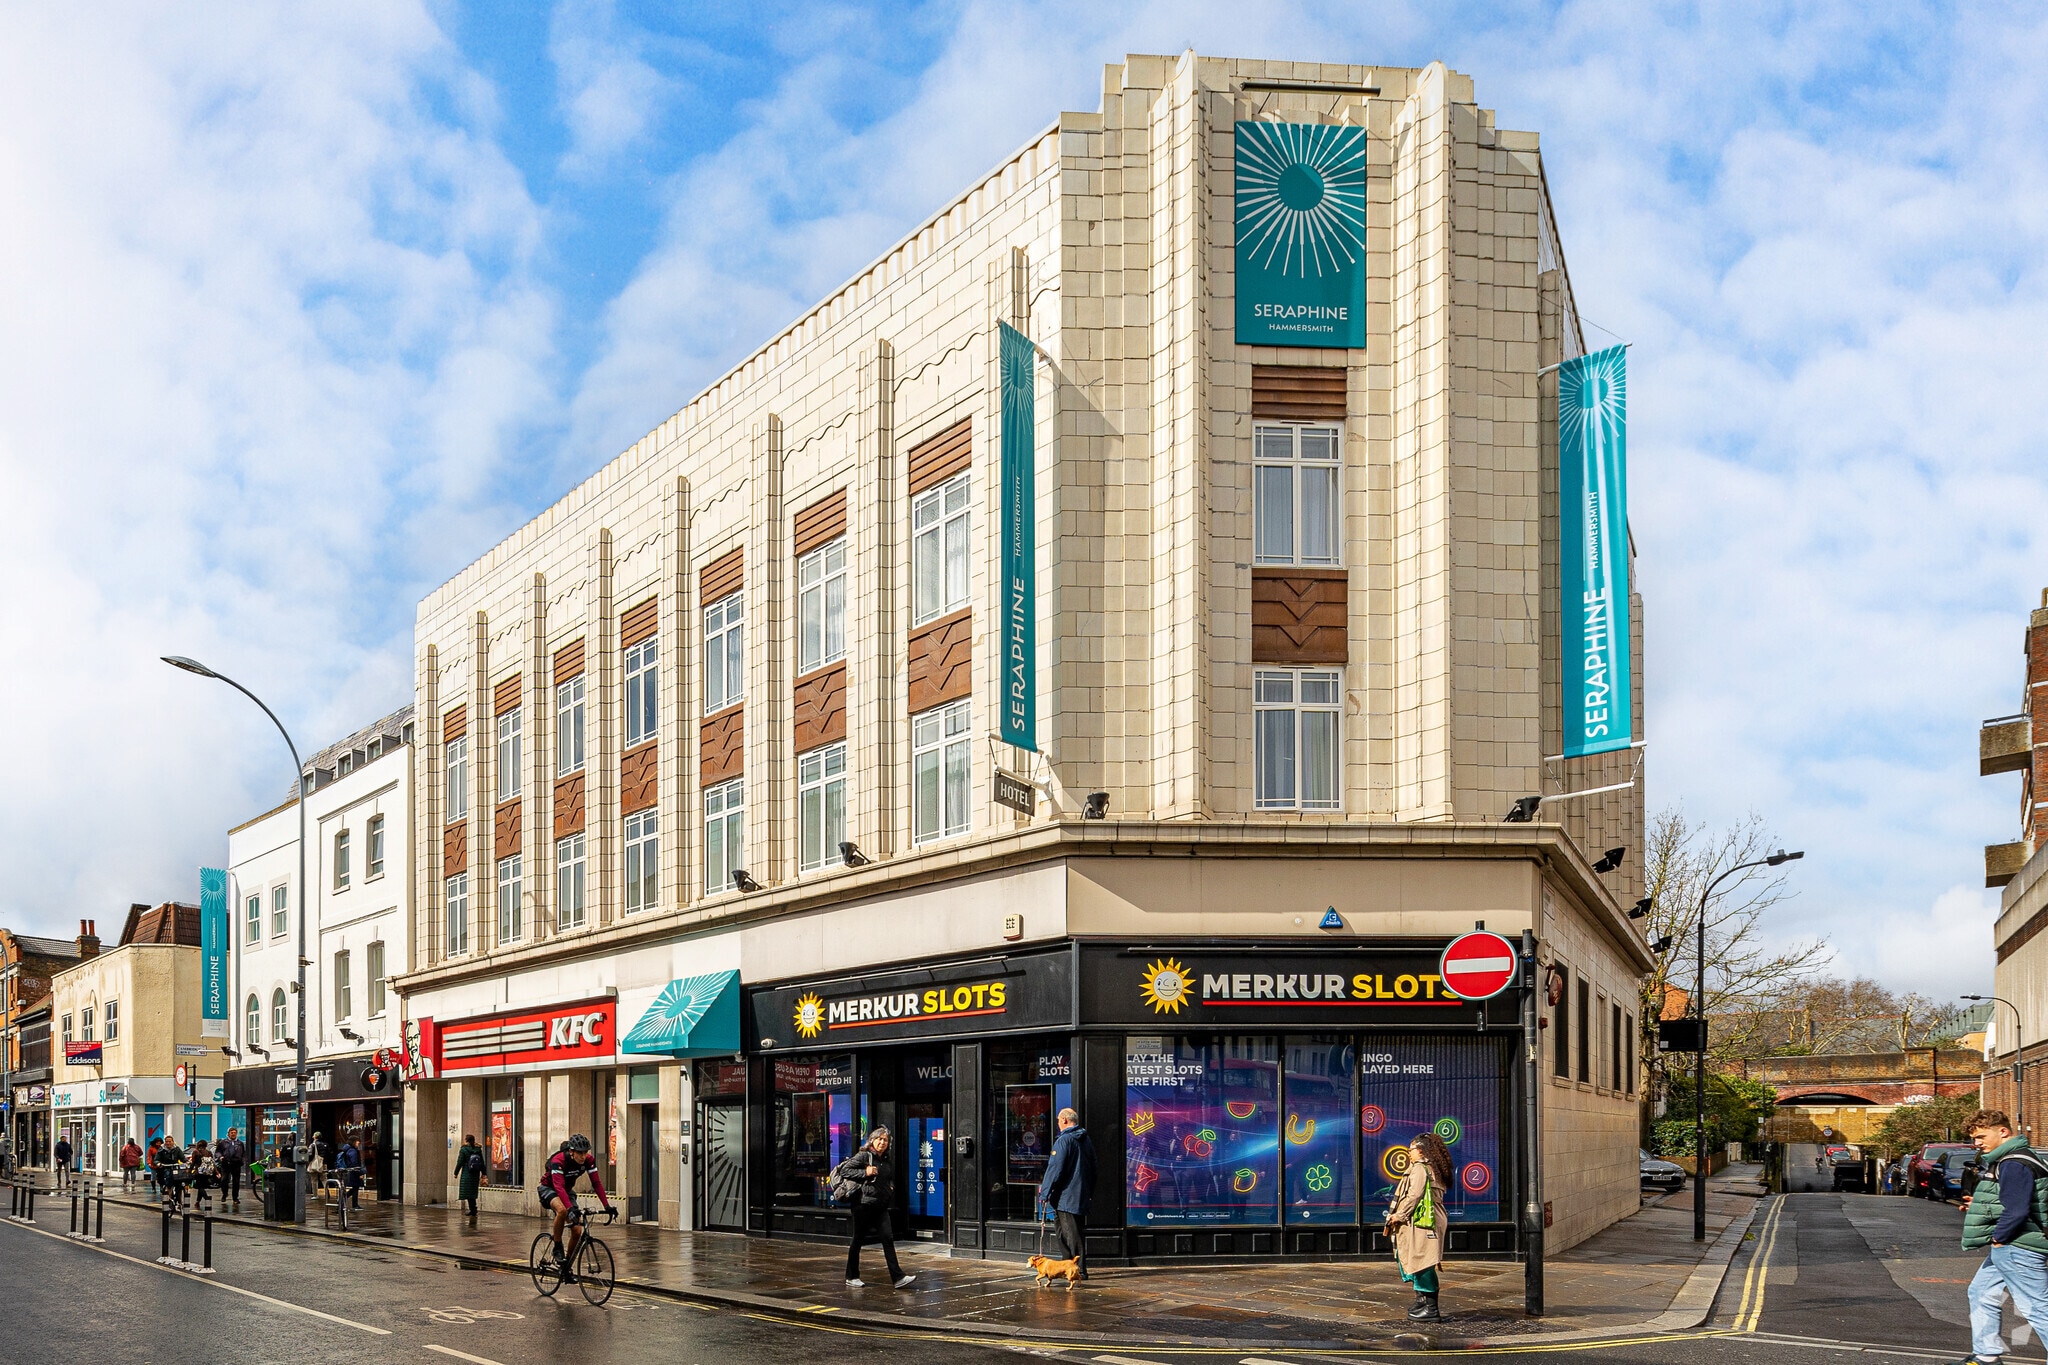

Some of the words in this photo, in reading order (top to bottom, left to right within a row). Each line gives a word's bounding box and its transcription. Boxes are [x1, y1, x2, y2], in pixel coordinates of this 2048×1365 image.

[1254, 303, 1348, 320] SERAPHINE
[1268, 323, 1334, 333] HAMMERSMITH
[1590, 490, 1599, 569] HAMMERSMITH
[1011, 576, 1025, 732] SERAPHINE
[1583, 586, 1610, 739] SERAPHINE
[1000, 782, 1030, 807] HOTEL
[210, 955, 220, 1015] SERAPHINE
[1202, 974, 1346, 999] MERKUR
[1351, 974, 1460, 999] SLOT
[828, 993, 920, 1024] MERKUR
[922, 982, 1006, 1014] SLOTS
[548, 1012, 605, 1048] KFC
[67, 1056, 101, 1064] Eddisons
[1039, 1055, 1063, 1066] PLAY
[1126, 1053, 1147, 1063] LAY
[1150, 1053, 1175, 1063] THE
[1363, 1053, 1393, 1063] INGO
[815, 1068, 838, 1077] BINGO
[1039, 1066, 1070, 1077] SLOTS
[1126, 1065, 1162, 1075] ATEST
[1164, 1065, 1203, 1075] SLOTS
[1363, 1064, 1400, 1074] LAYED
[1403, 1064, 1434, 1074] HERE
[815, 1077, 842, 1086] PLAYED
[1127, 1076, 1150, 1086] ERE
[1152, 1076, 1186, 1086] FIRST
[1365, 1111, 1375, 1124] 3
[1441, 1123, 1450, 1135] 6
[1395, 1153, 1407, 1169] 8
[1471, 1169, 1481, 1181] 2
